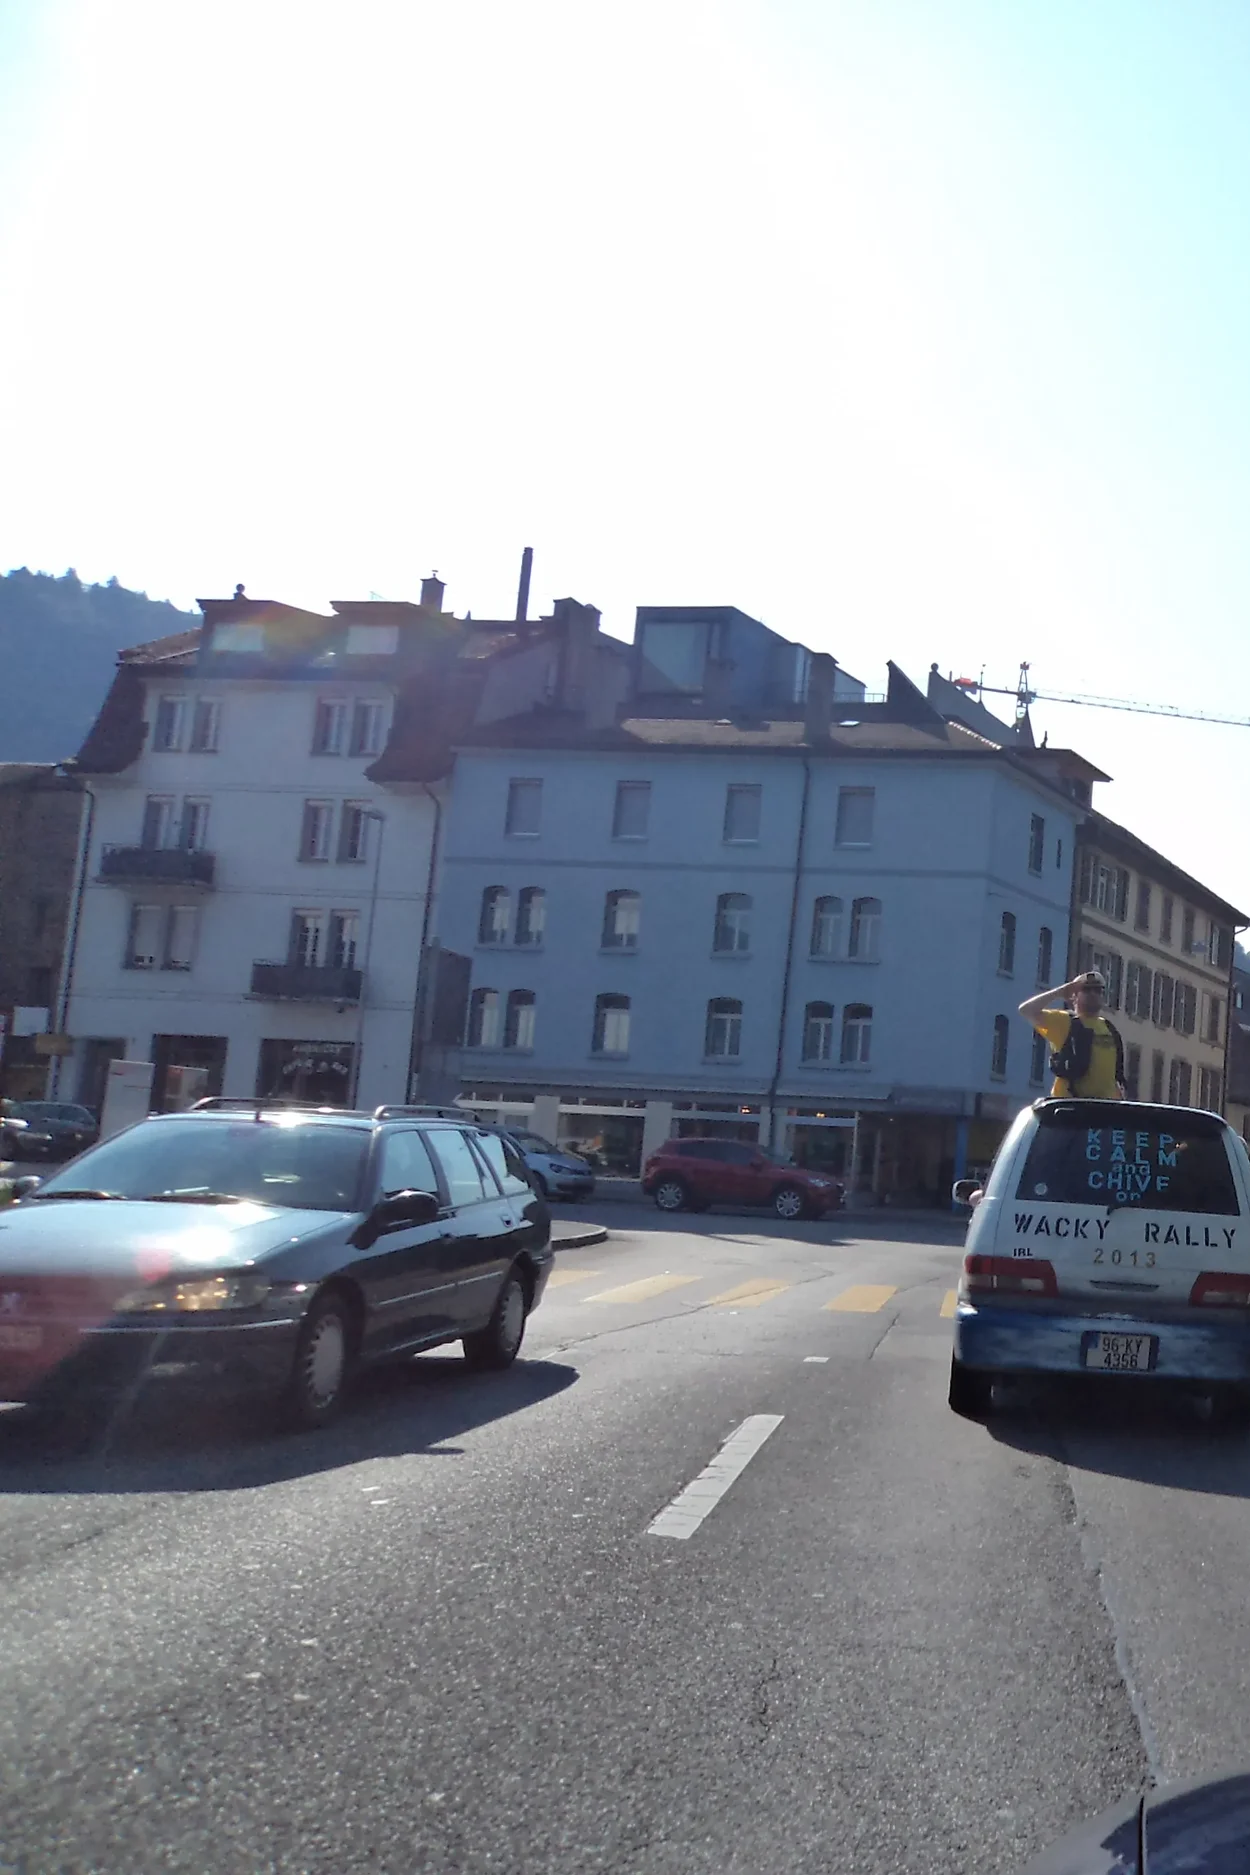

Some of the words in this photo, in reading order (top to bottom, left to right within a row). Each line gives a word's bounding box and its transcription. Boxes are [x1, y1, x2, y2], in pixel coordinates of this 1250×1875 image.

[1087, 1128, 1174, 1149] KEEP
[1086, 1144, 1177, 1167] CALM
[1112, 1161, 1151, 1175] and
[1116, 1191, 1141, 1202] on
[1014, 1213, 1110, 1240] WACKY
[1144, 1222, 1236, 1249] RALLY
[1013, 1247, 1034, 1257] IRL
[1093, 1248, 1157, 1269] 2013
[1102, 1336, 1143, 1354] 96-KY
